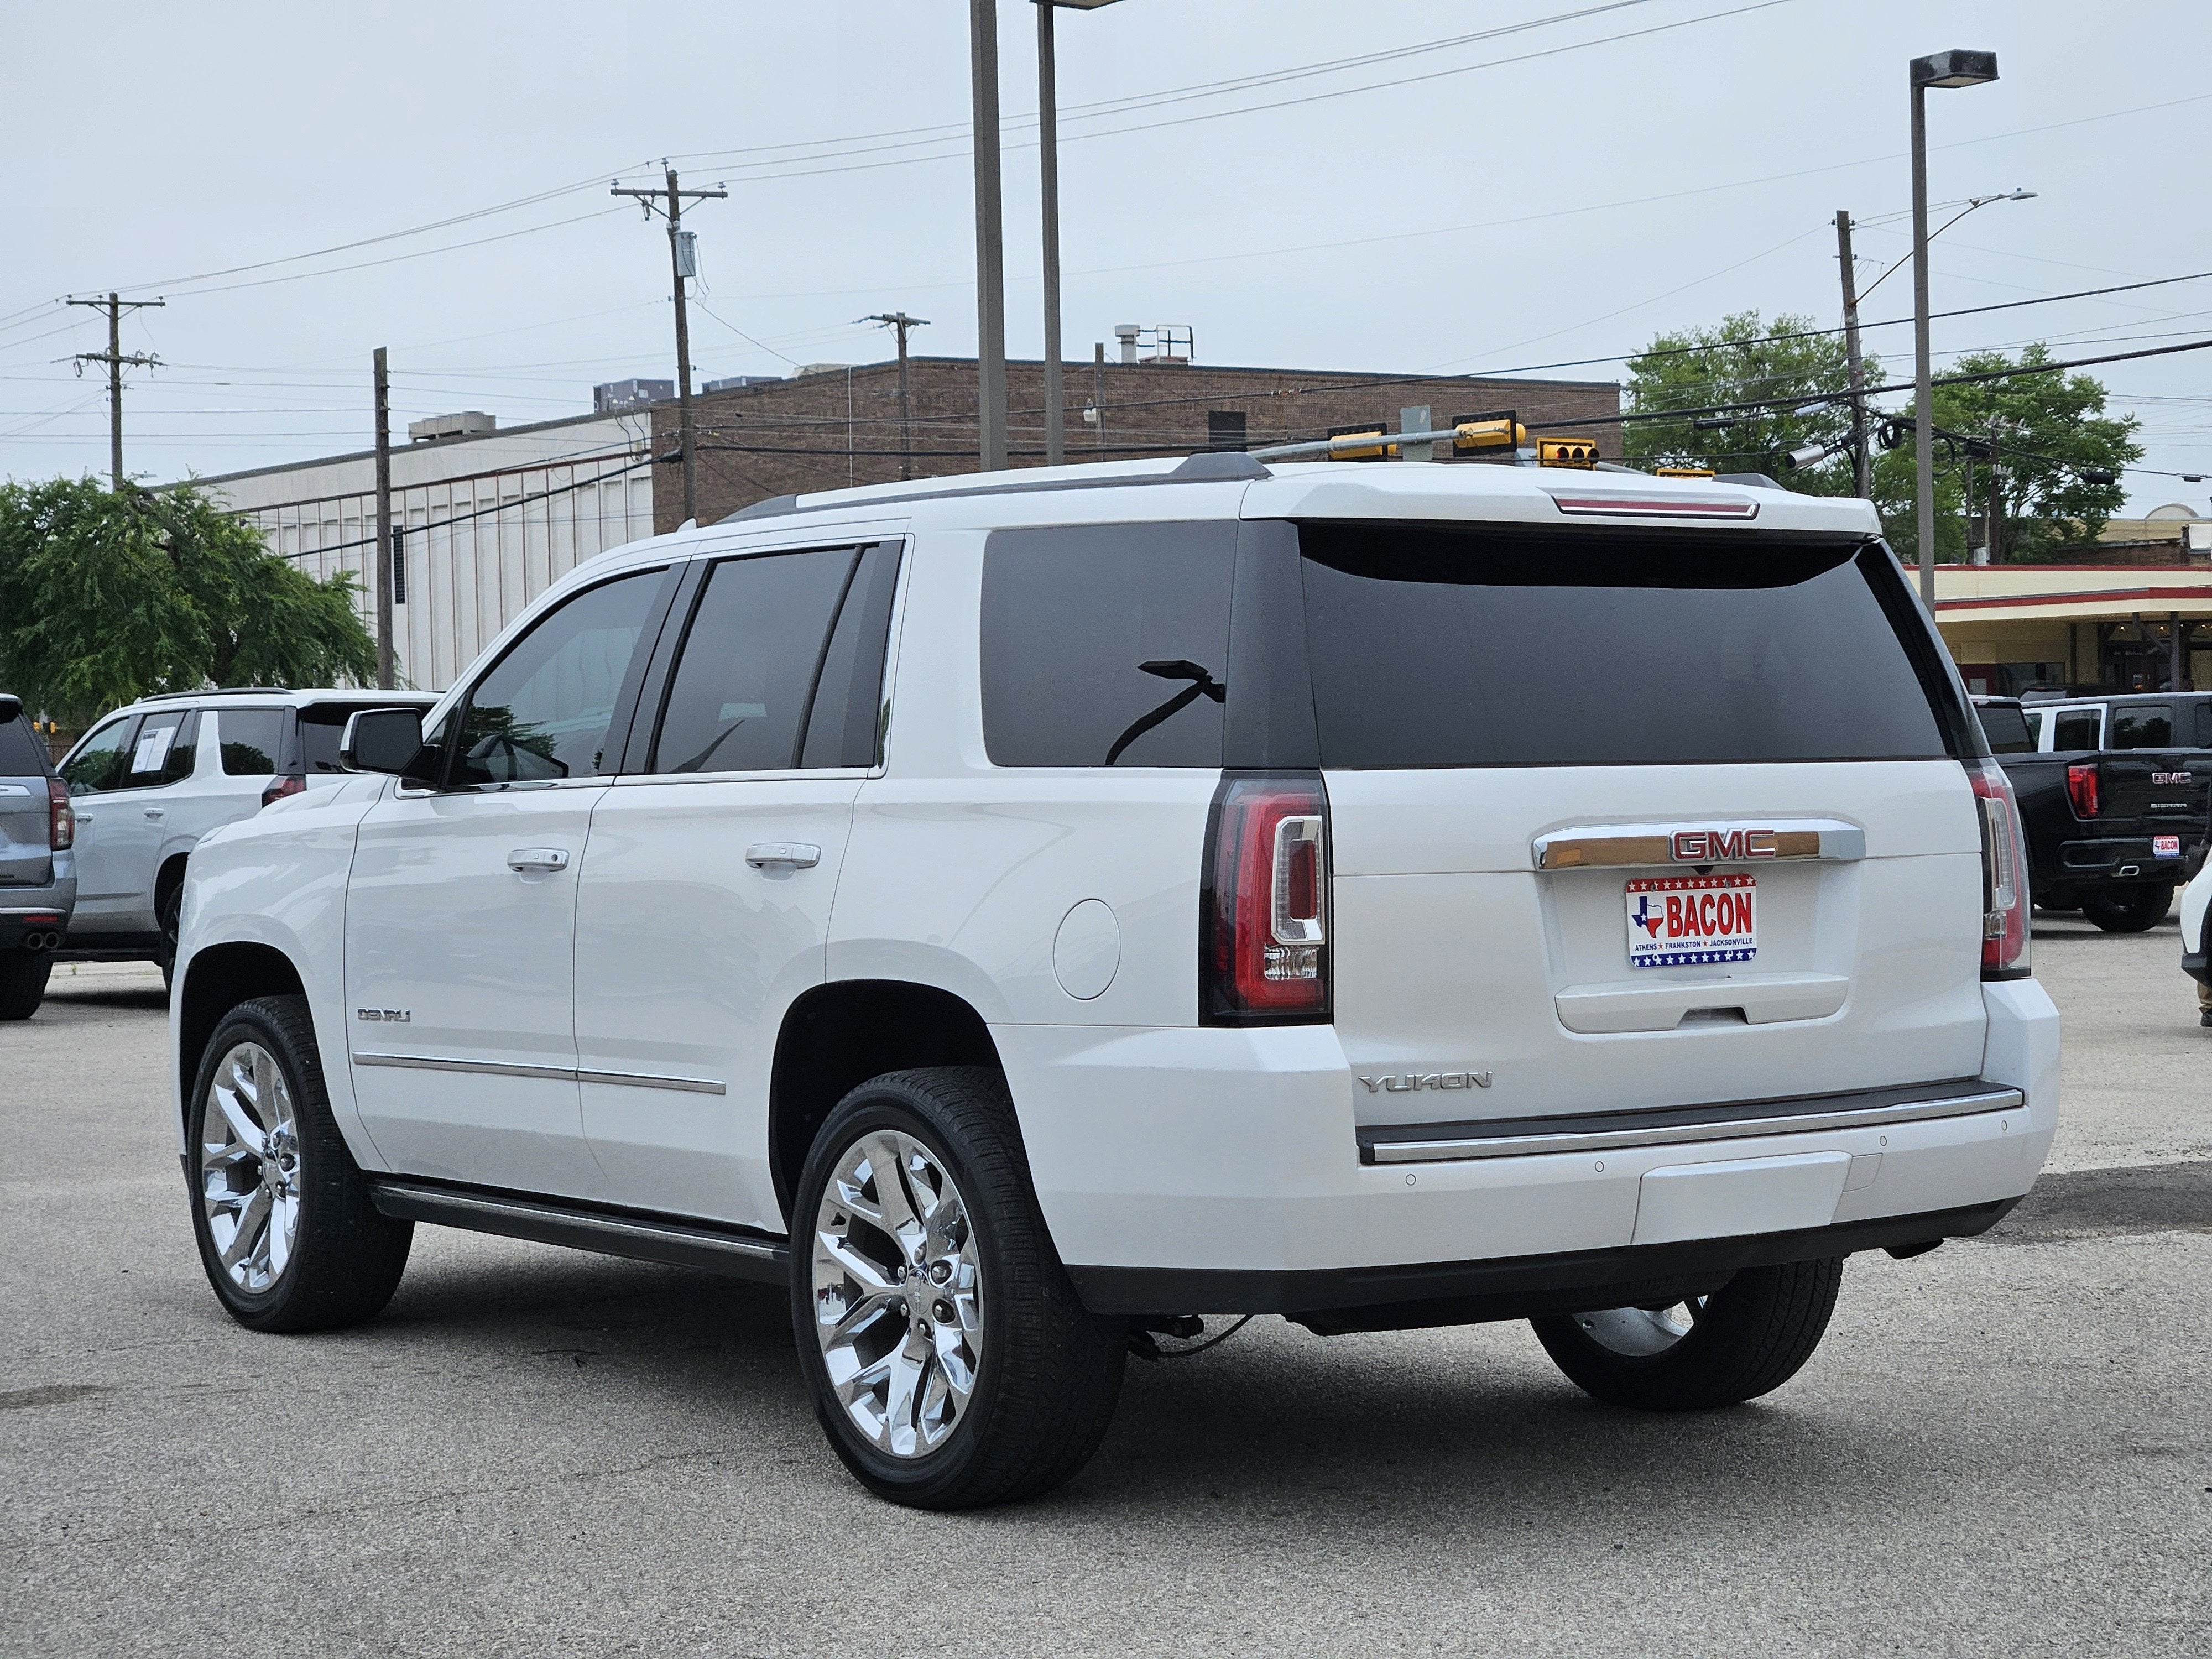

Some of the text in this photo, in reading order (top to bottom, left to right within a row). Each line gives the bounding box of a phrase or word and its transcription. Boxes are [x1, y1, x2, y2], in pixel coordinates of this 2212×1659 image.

[2152, 772, 2191, 784] GMC
[1670, 828, 1776, 862] GMC
[2161, 841, 2178, 850] BACON
[1666, 892, 1752, 938] BACON
[1635, 938, 1753, 951] ATHENS FRANKSTON JACKSONVILLE
[357, 1008, 410, 1022] DENALI
[1358, 1071, 1493, 1093] YUKON
